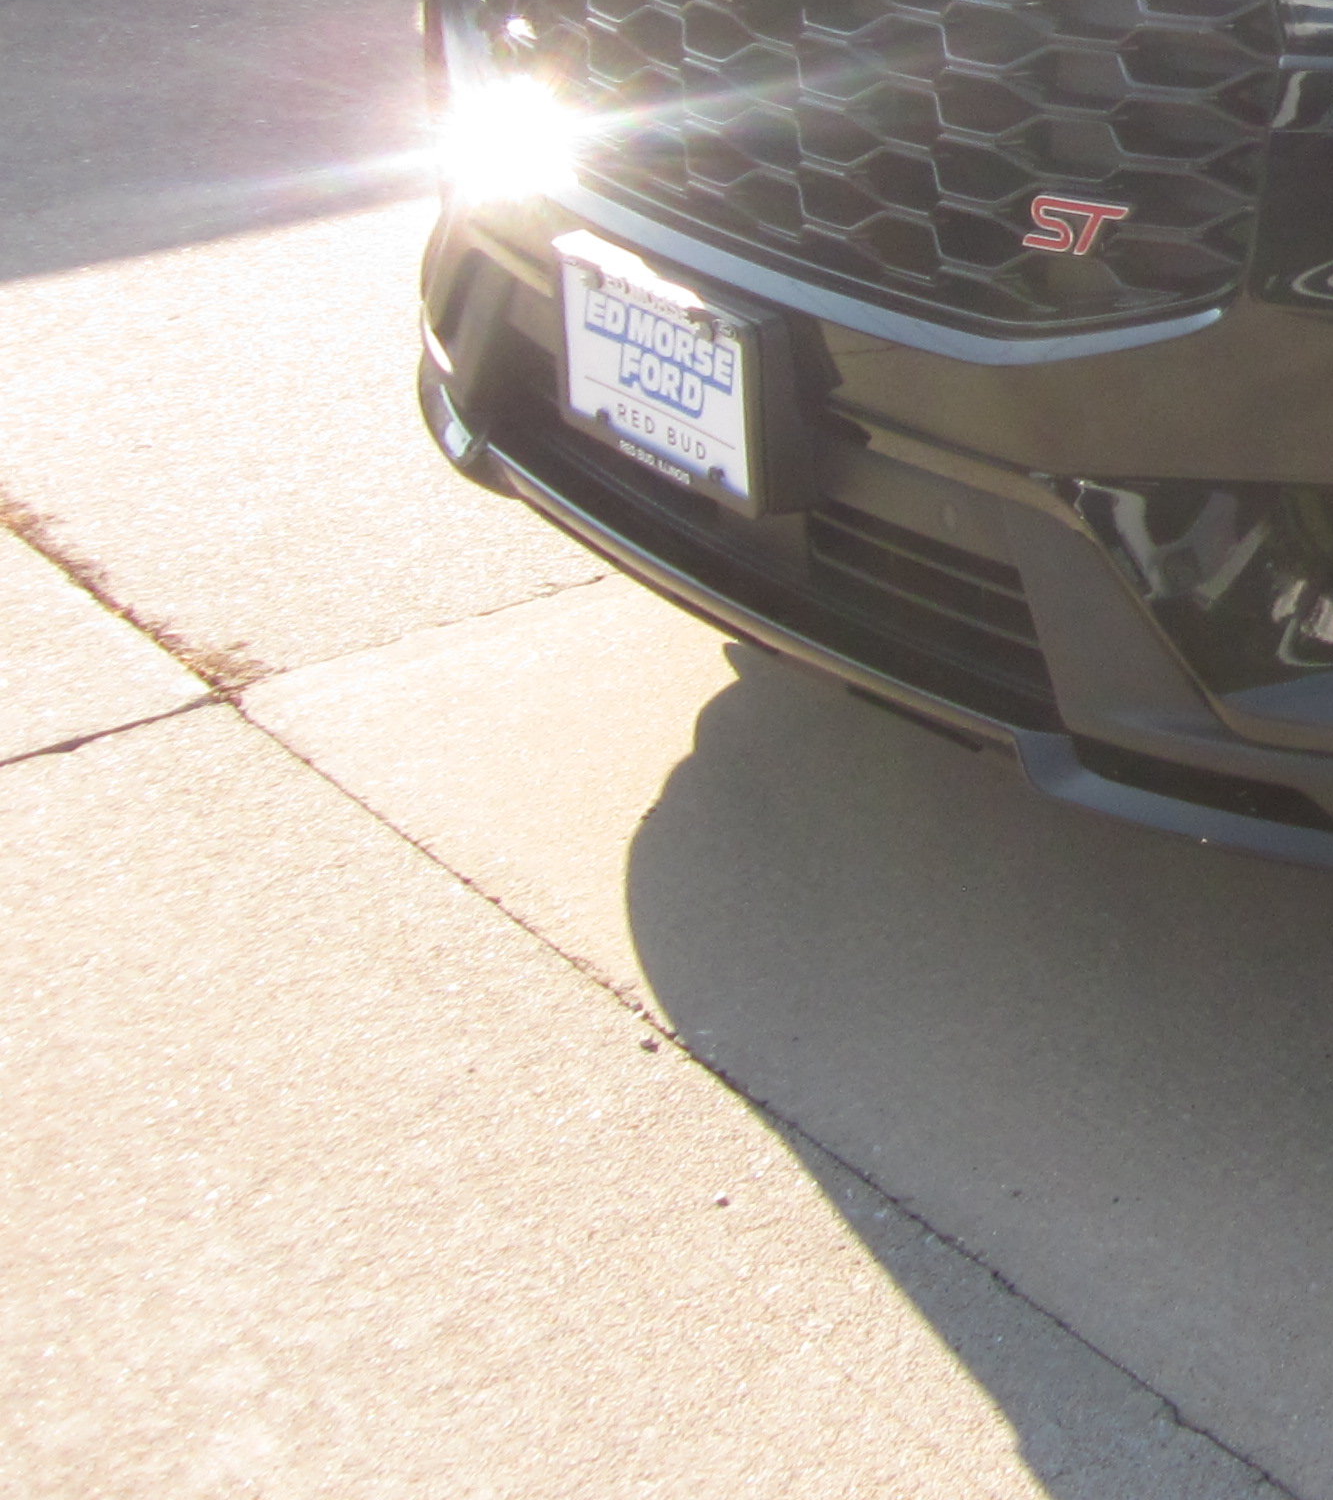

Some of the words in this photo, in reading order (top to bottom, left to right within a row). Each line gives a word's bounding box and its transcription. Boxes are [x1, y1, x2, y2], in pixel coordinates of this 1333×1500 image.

[1022, 195, 1128, 256] ST
[585, 289, 626, 338] ED
[627, 303, 735, 394] MORSE
[619, 343, 704, 418] FORD
[618, 403, 656, 435] RED
[667, 427, 707, 460] BUD
